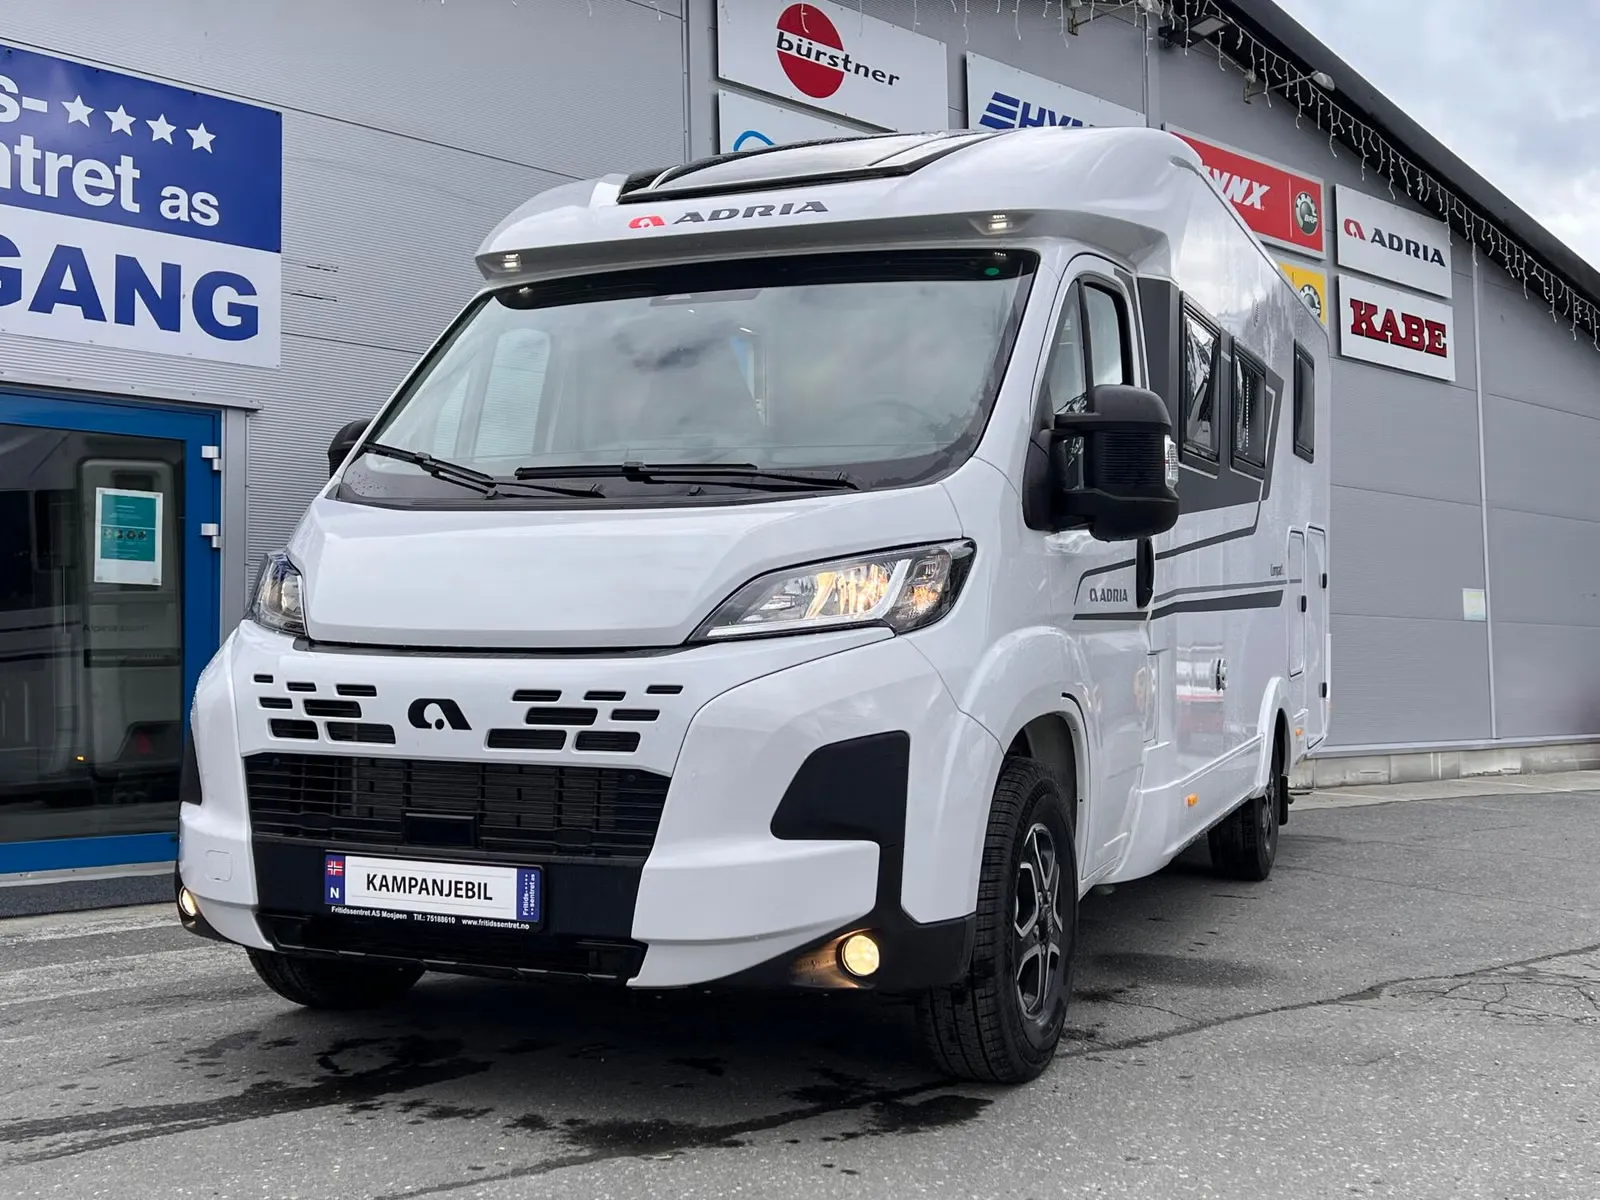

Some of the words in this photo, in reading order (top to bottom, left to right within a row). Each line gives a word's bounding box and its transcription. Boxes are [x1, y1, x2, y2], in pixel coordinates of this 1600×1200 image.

[776, 31, 900, 86] bürstner
[159, 184, 220, 227] as
[672, 200, 829, 225] ADRIA
[1370, 227, 1446, 267] ADRIA
[1349, 297, 1448, 358] KABE
[1099, 588, 1128, 602] ADRIA
[330, 887, 340, 899] N
[365, 873, 493, 901] KAMPANJEBIL
[331, 906, 371, 917] Fritidssentret
[461, 918, 530, 930] www.fritidssentret.no
